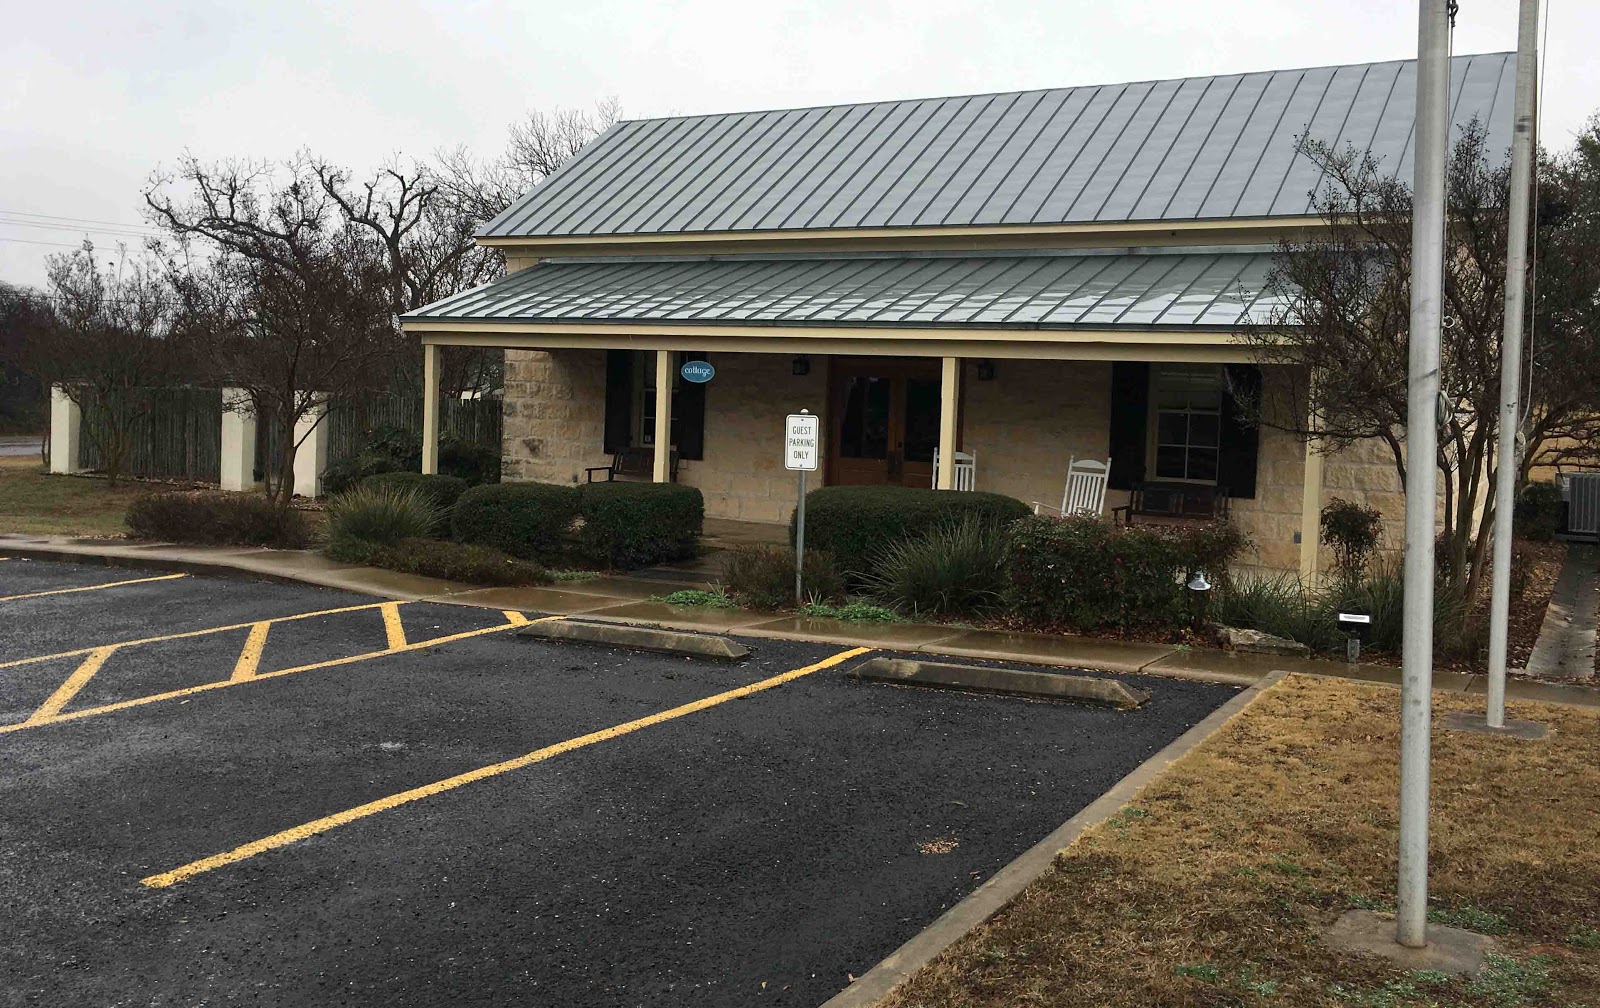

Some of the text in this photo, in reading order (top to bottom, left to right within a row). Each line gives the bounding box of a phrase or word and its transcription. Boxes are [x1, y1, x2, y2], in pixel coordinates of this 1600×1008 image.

[684, 366, 711, 377] cottage
[792, 426, 812, 435] GUEST
[789, 438, 815, 447] PARKING
[793, 450, 809, 459] ONLY
